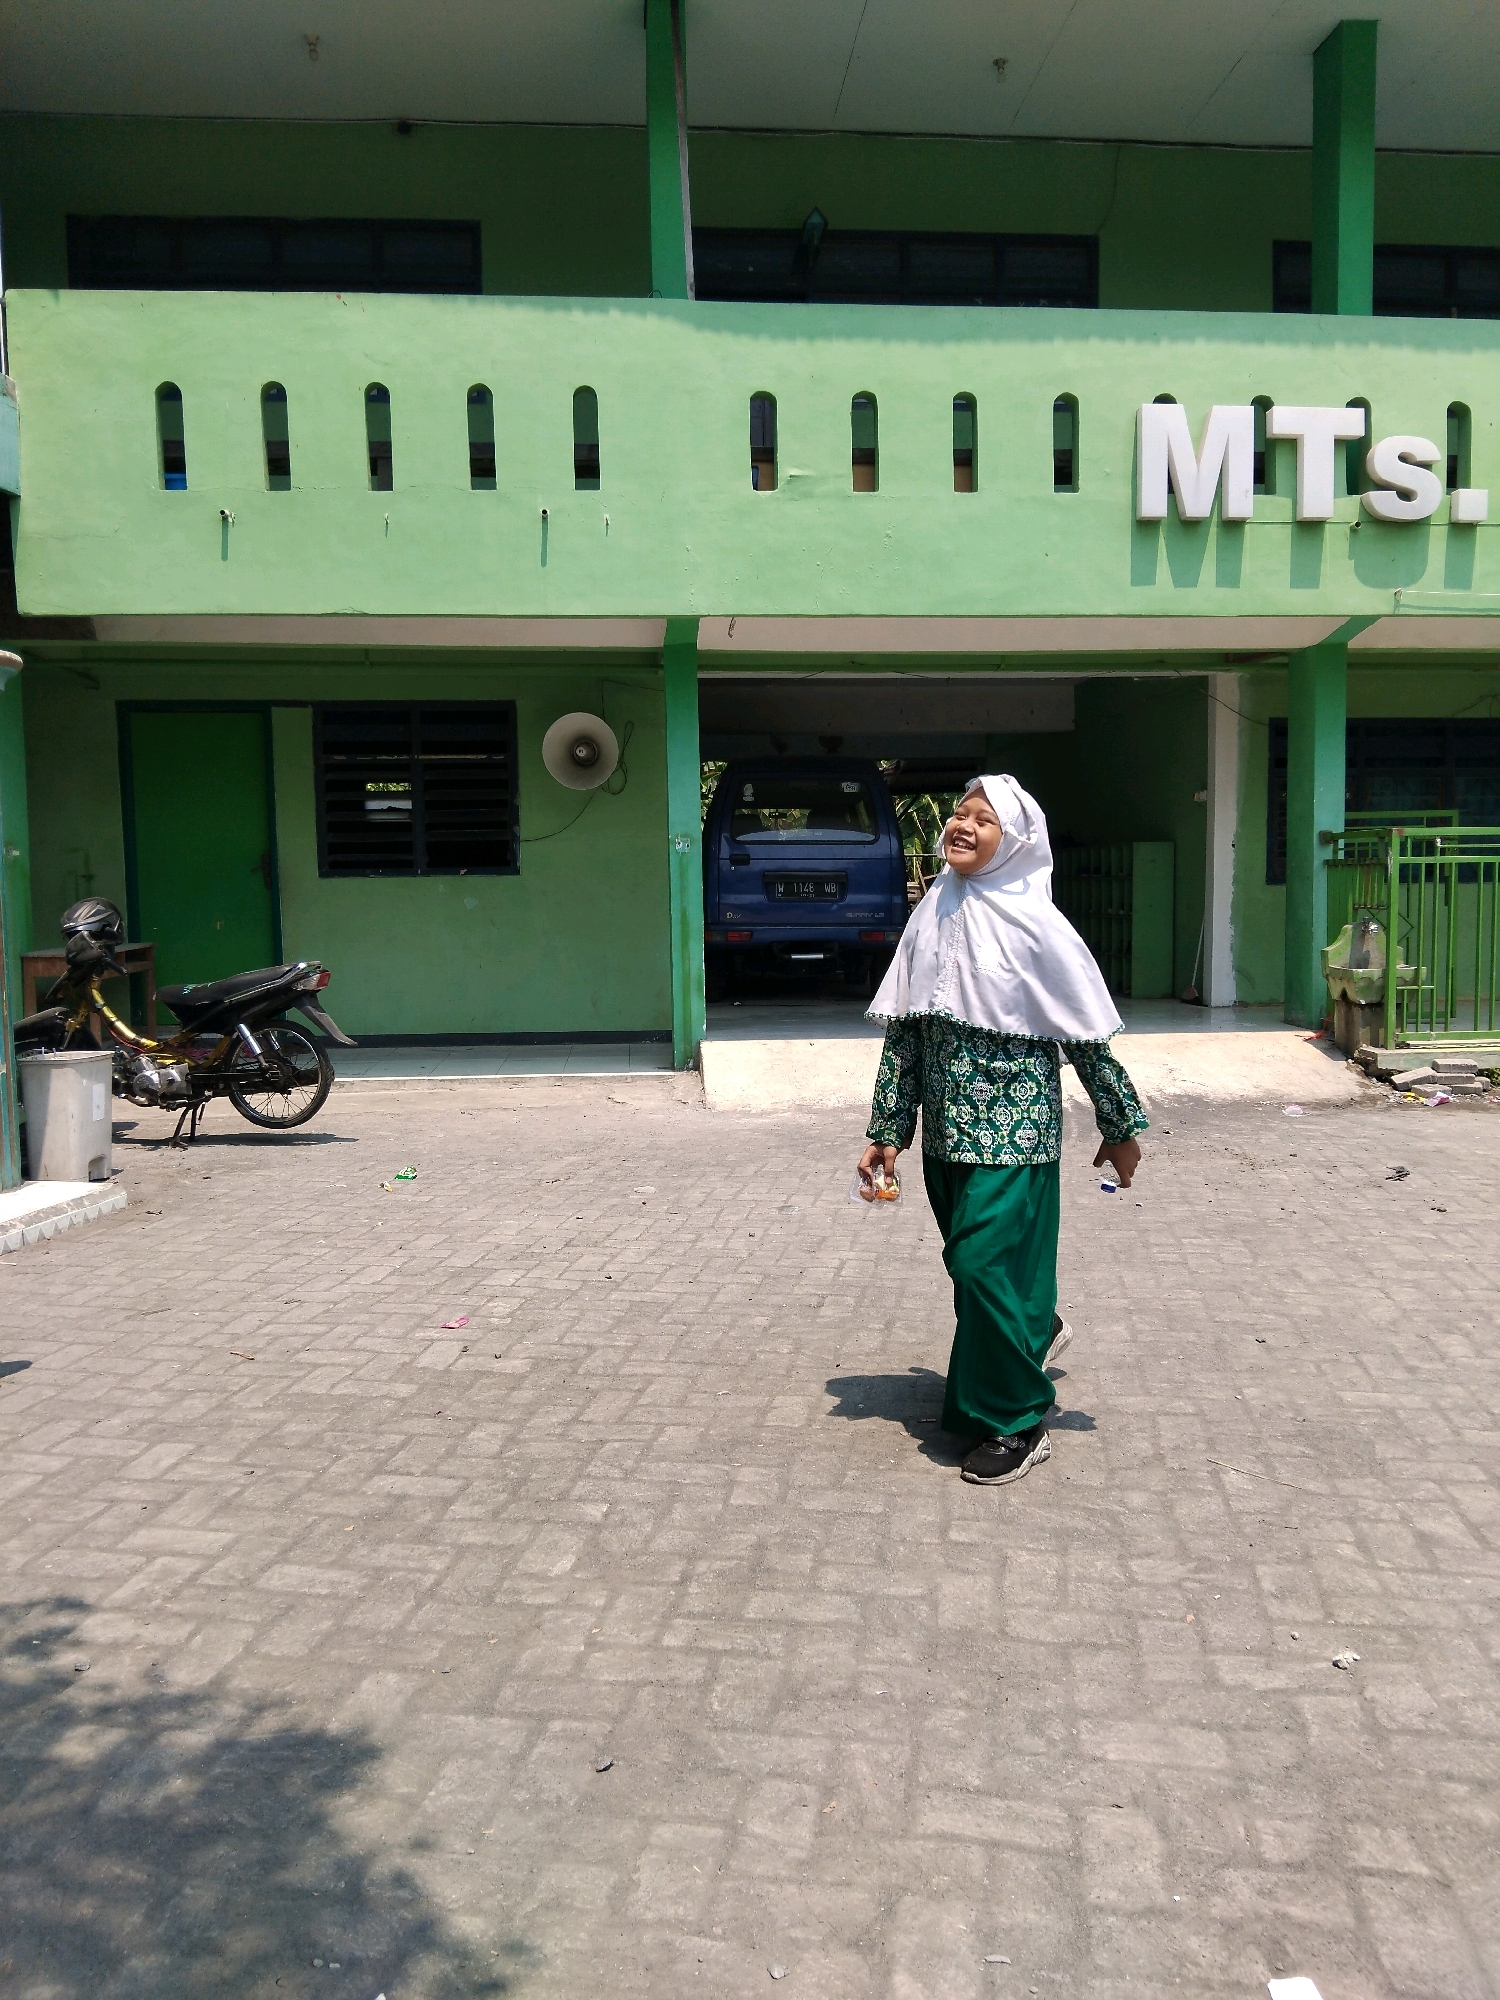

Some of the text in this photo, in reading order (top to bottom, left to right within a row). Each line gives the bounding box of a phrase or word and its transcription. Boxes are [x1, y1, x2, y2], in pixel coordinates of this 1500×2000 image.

[1136, 403, 1489, 524] MTs.
[778, 882, 785, 893] W
[824, 882, 837, 893] WB
